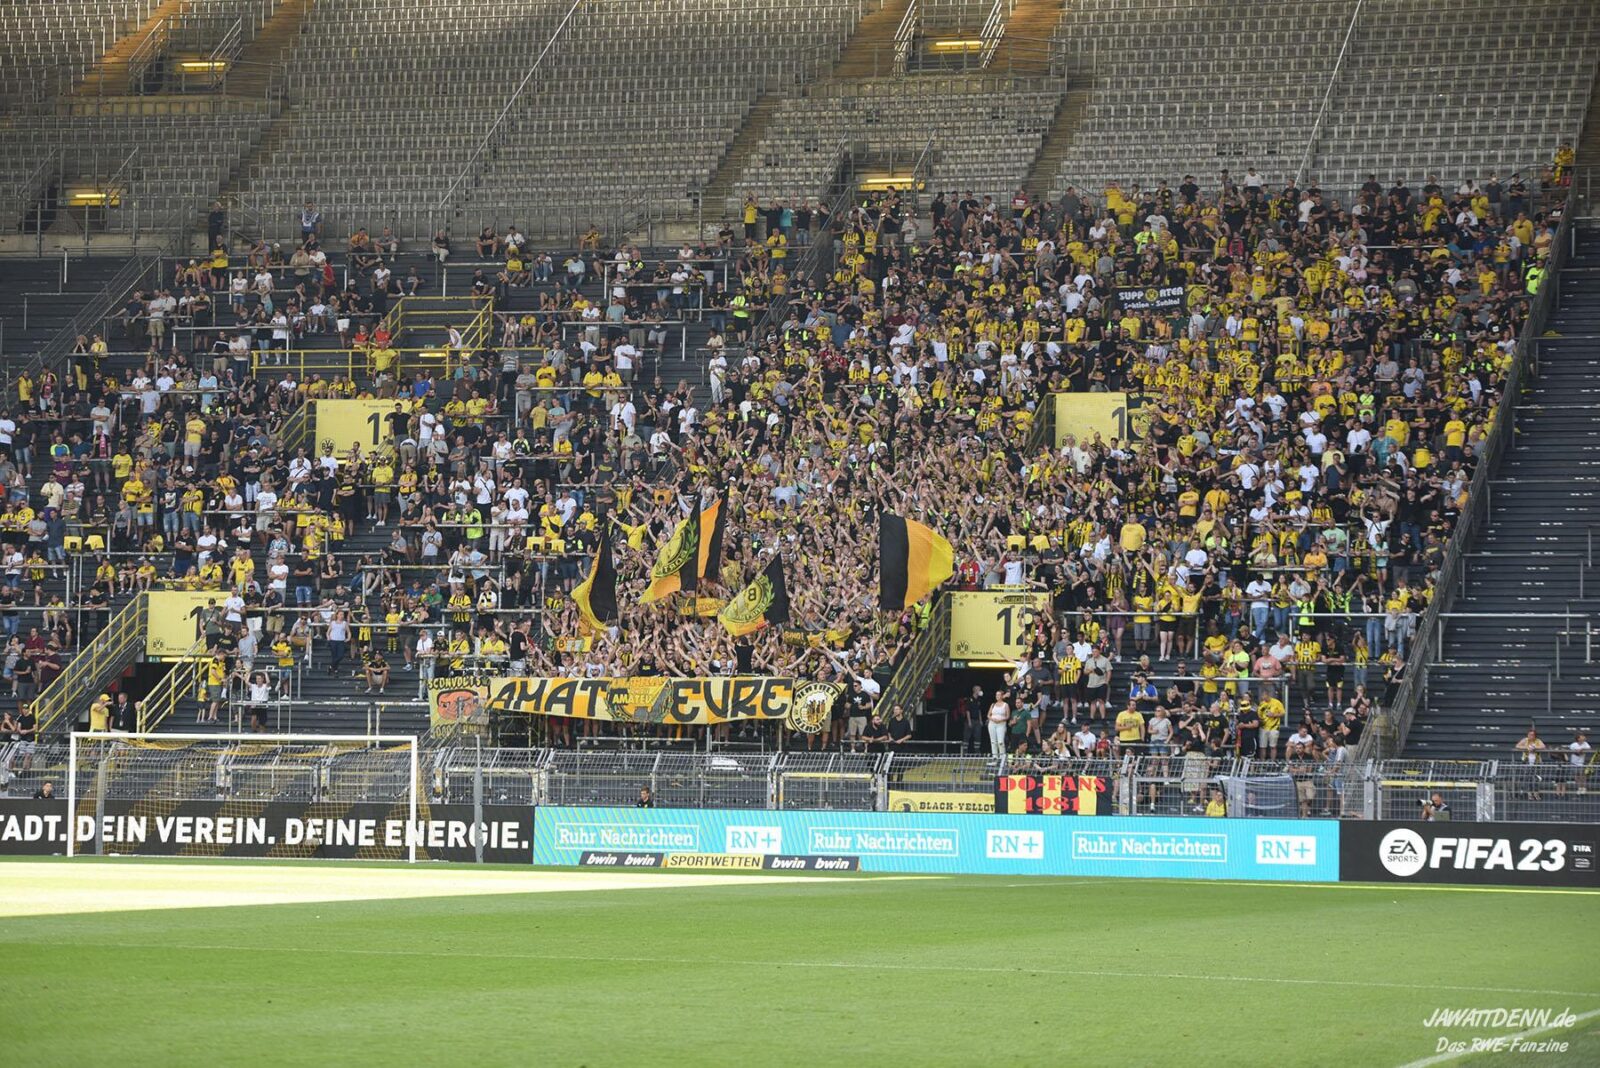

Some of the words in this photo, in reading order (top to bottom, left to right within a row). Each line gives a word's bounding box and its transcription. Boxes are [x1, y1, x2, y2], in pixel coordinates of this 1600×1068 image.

[999, 776, 1106, 792] DO-FANS
[1025, 796, 1080, 811] 1981
[77, 815, 147, 842] DEIN
[155, 816, 275, 844] VEREIN.
[285, 818, 376, 846] DEINE
[385, 819, 529, 849] ENERGIE.
[560, 828, 597, 845] Ruhr
[600, 828, 693, 846] Nachrichten
[814, 832, 851, 849] Ruhr
[856, 833, 953, 850] Nachrichten
[1078, 836, 1117, 854] Ruhr
[1121, 837, 1221, 856] Nachrichten
[1389, 840, 1417, 855] EA
[586, 853, 617, 865] bwin
[624, 854, 656, 866] bwin
[670, 856, 761, 868] SPORTWETTEN
[1429, 837, 1514, 870] FIFA
[1516, 839, 1567, 872] 23
[771, 857, 805, 869] bwin
[815, 858, 849, 869] bwin
